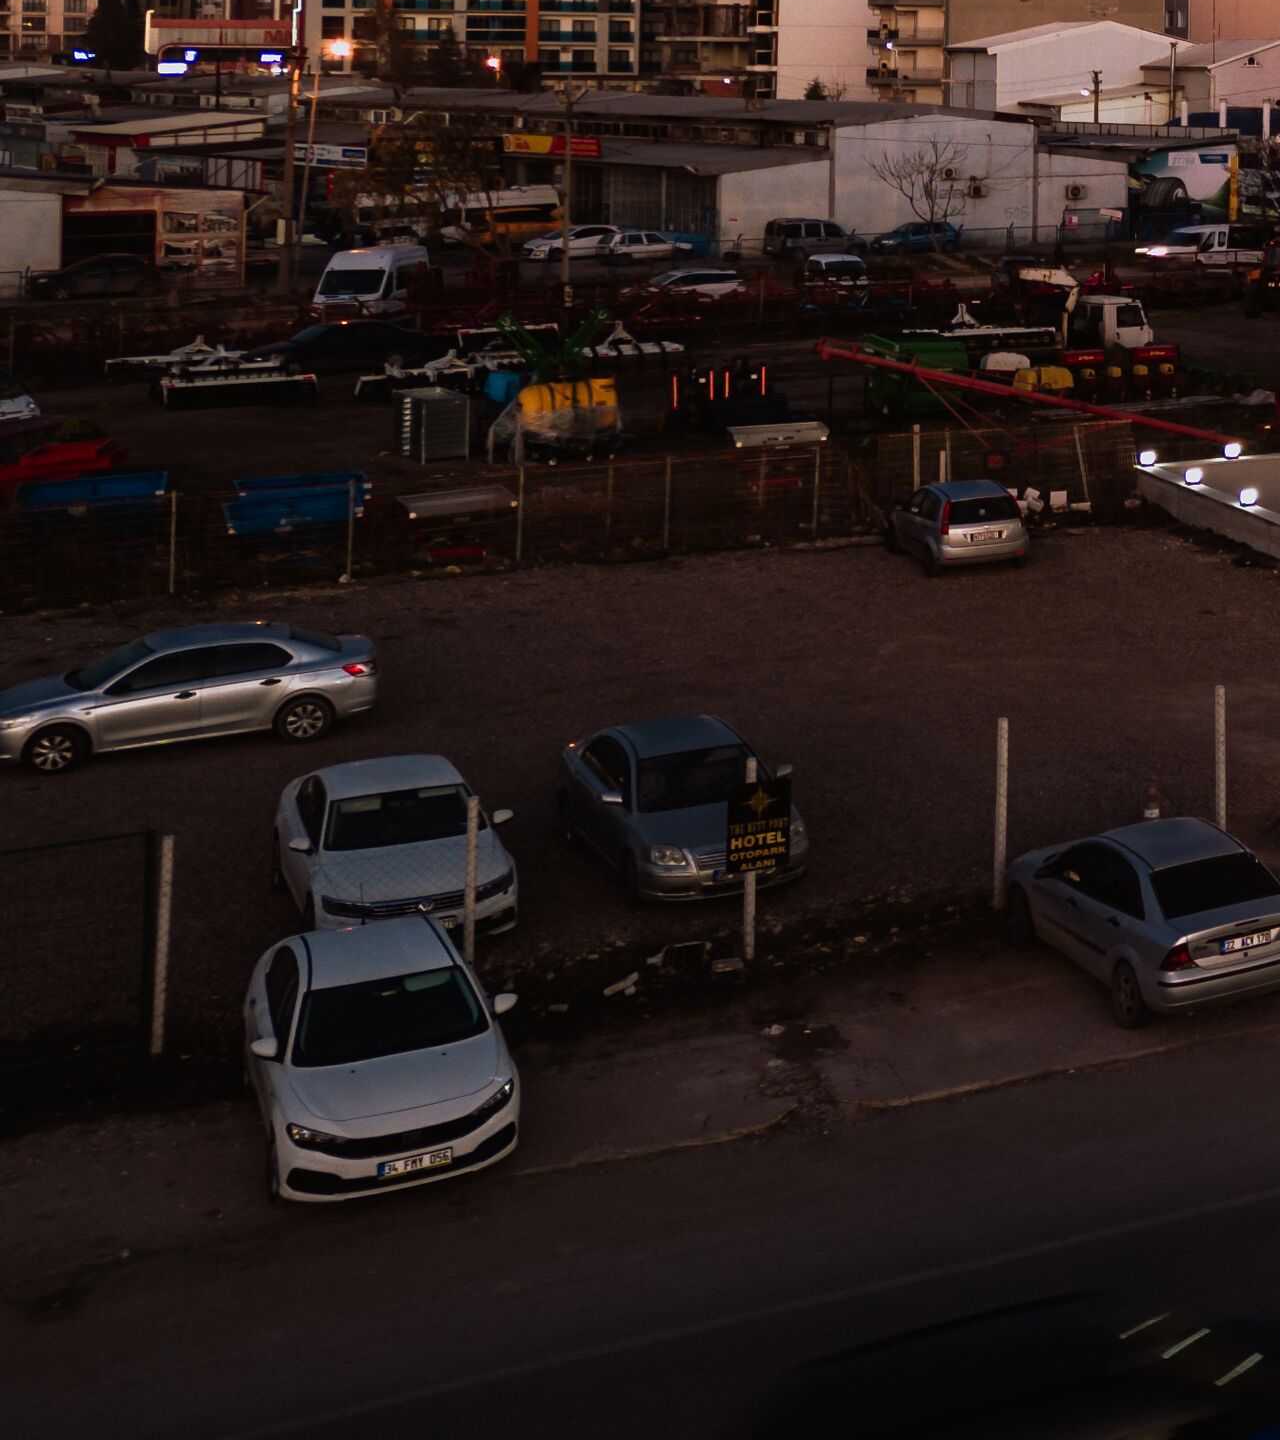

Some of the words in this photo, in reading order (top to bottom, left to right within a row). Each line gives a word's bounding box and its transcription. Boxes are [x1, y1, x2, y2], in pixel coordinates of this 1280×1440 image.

[730, 831, 787, 850] HOTEL
[729, 846, 786, 861] OTOPARK
[740, 859, 776, 871] ALANI
[385, 1164, 398, 1174] 34
